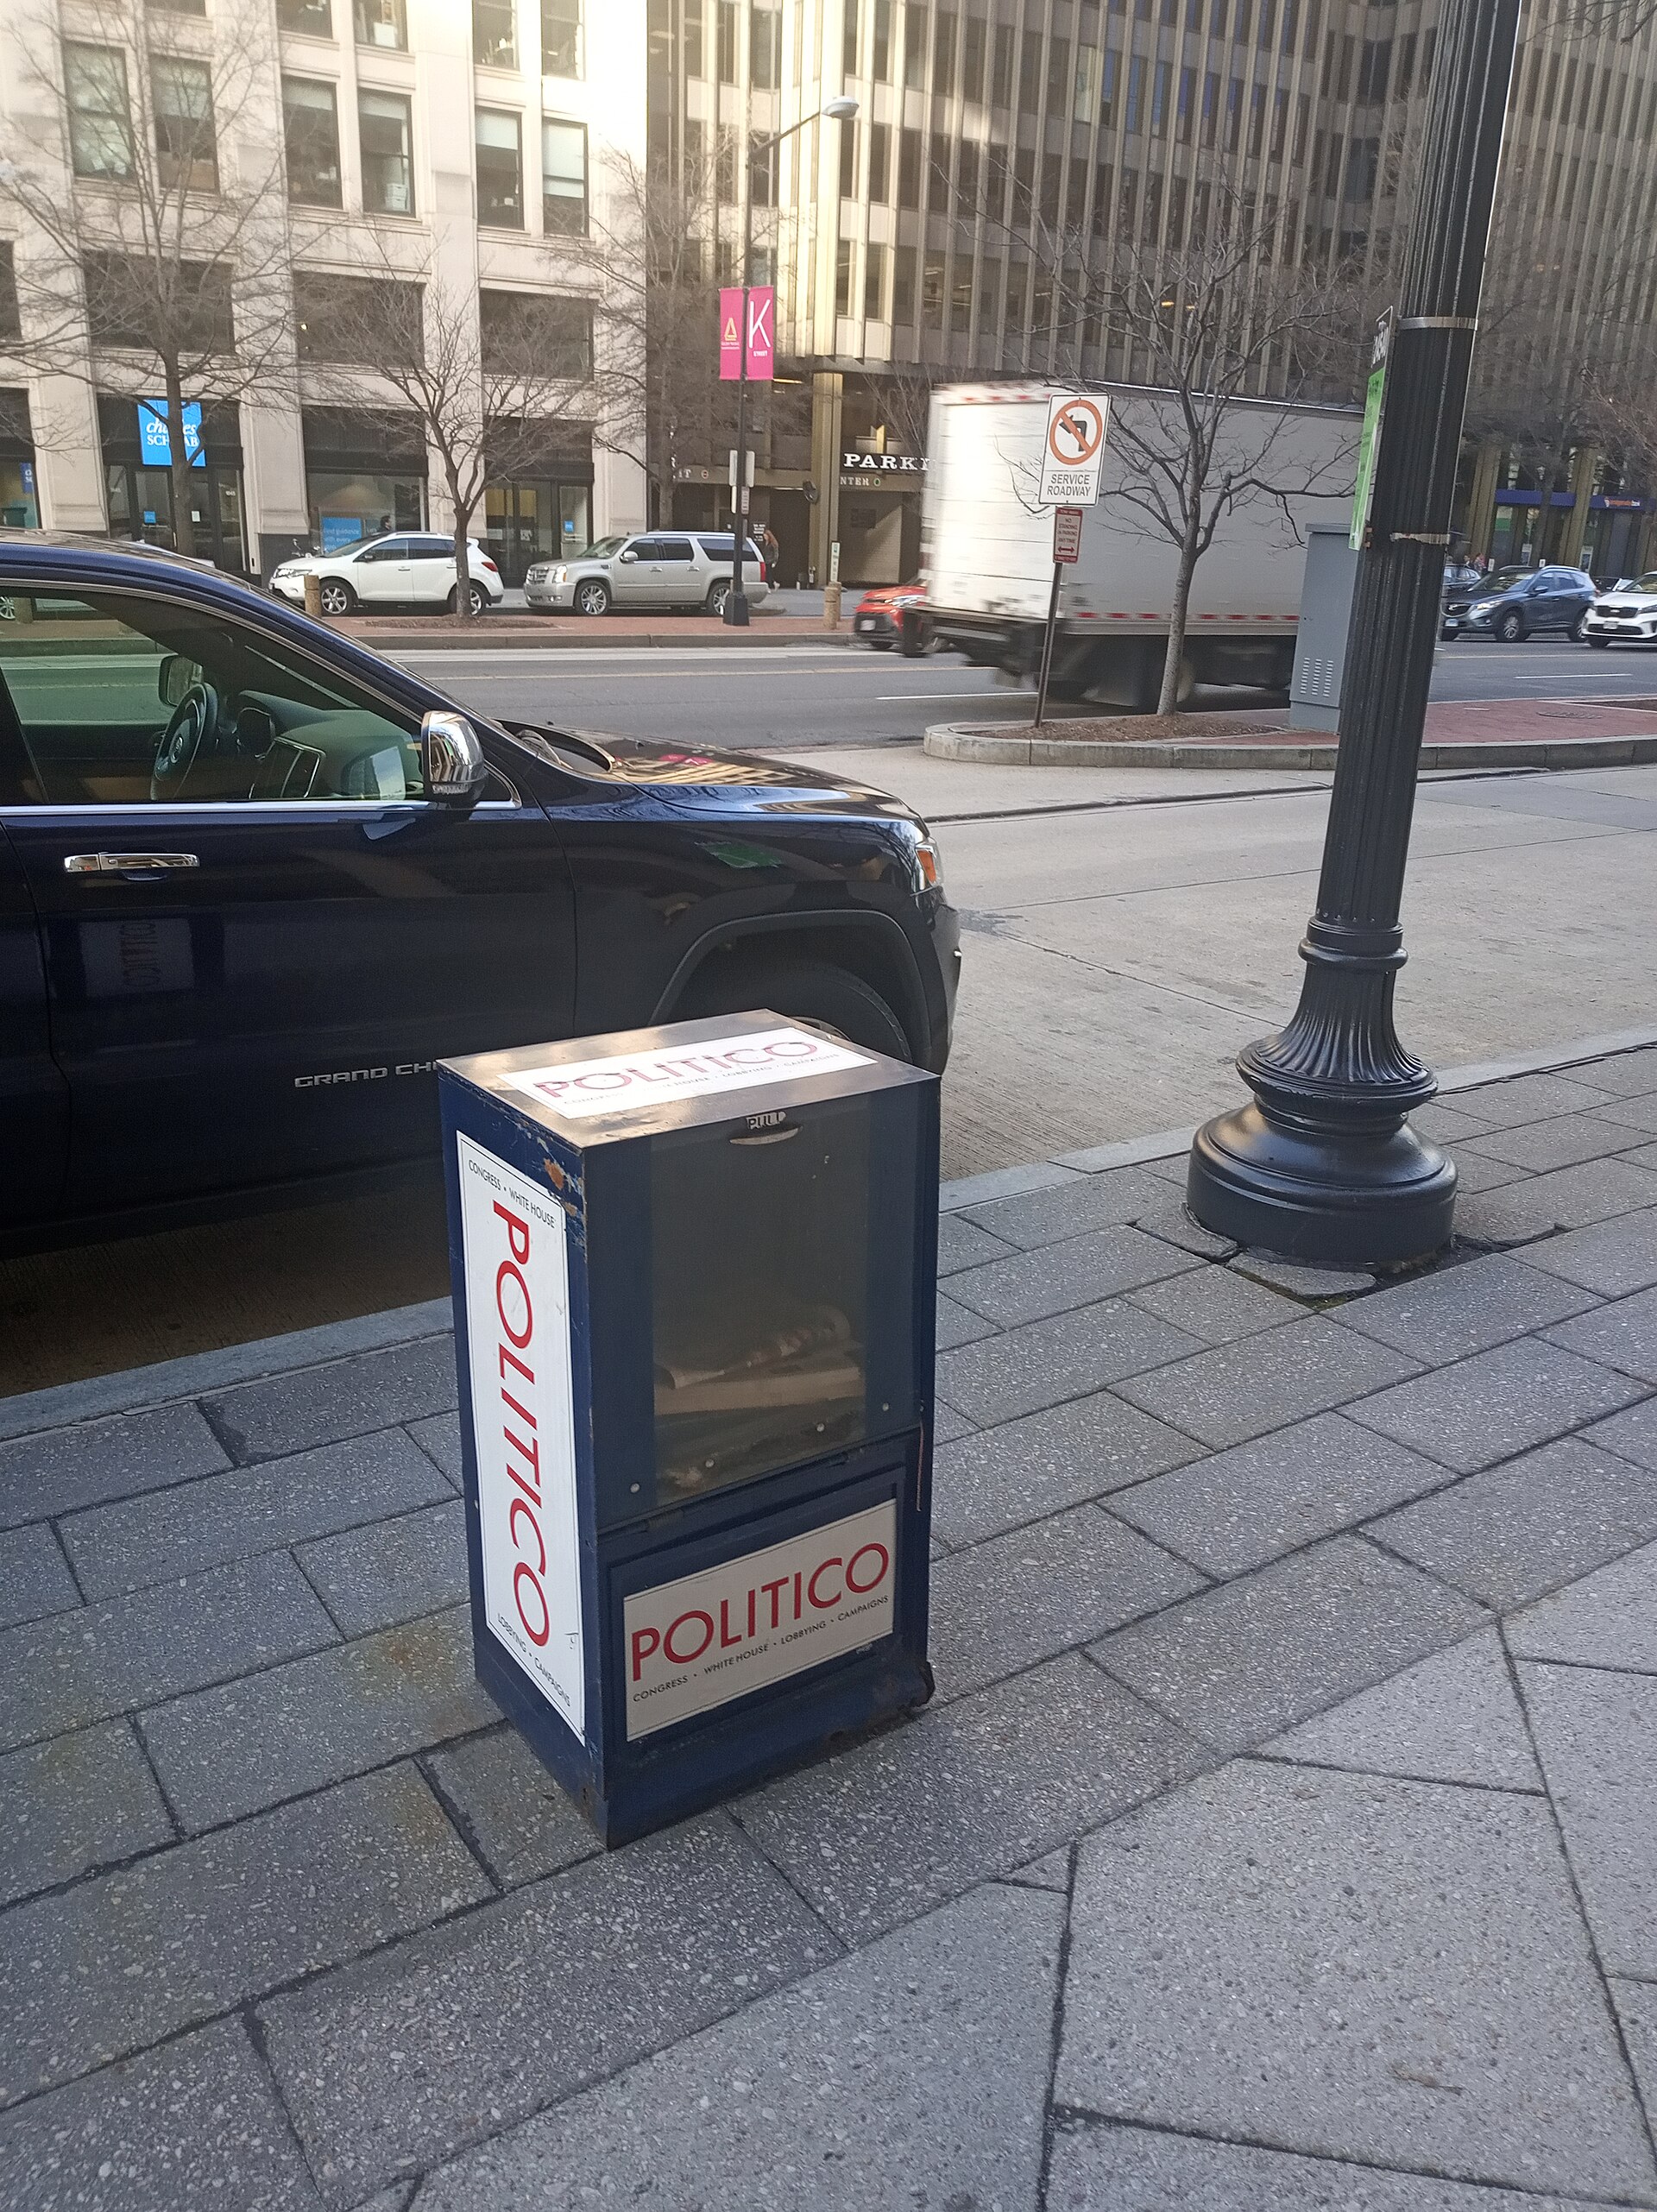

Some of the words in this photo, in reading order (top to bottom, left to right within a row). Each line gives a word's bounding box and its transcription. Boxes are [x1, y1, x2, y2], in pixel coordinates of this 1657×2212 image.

[748, 299, 771, 349] K
[147, 435, 198, 447] SCHAB
[840, 476, 870, 487] NTER
[1047, 486, 1091, 496] ROADWAY
[1050, 474, 1090, 485] SERVICE
[294, 1067, 388, 1087] GRAND
[533, 1042, 817, 1098] POLITICO
[746, 1111, 786, 1130] PULL
[469, 1160, 501, 1191] CONGRESS
[509, 1187, 530, 1211] WHITE
[531, 1202, 555, 1229] HOUSE
[493, 1200, 550, 1647] POLITICO
[632, 1543, 889, 1681] POLITICO
[633, 1674, 688, 1702] CONGRESS
[703, 1656, 734, 1675] WHITE
[735, 1643, 769, 1663] HOUSE
[780, 1620, 827, 1645] LOBBYING
[837, 1595, 889, 1622] CAMPAIGNS
